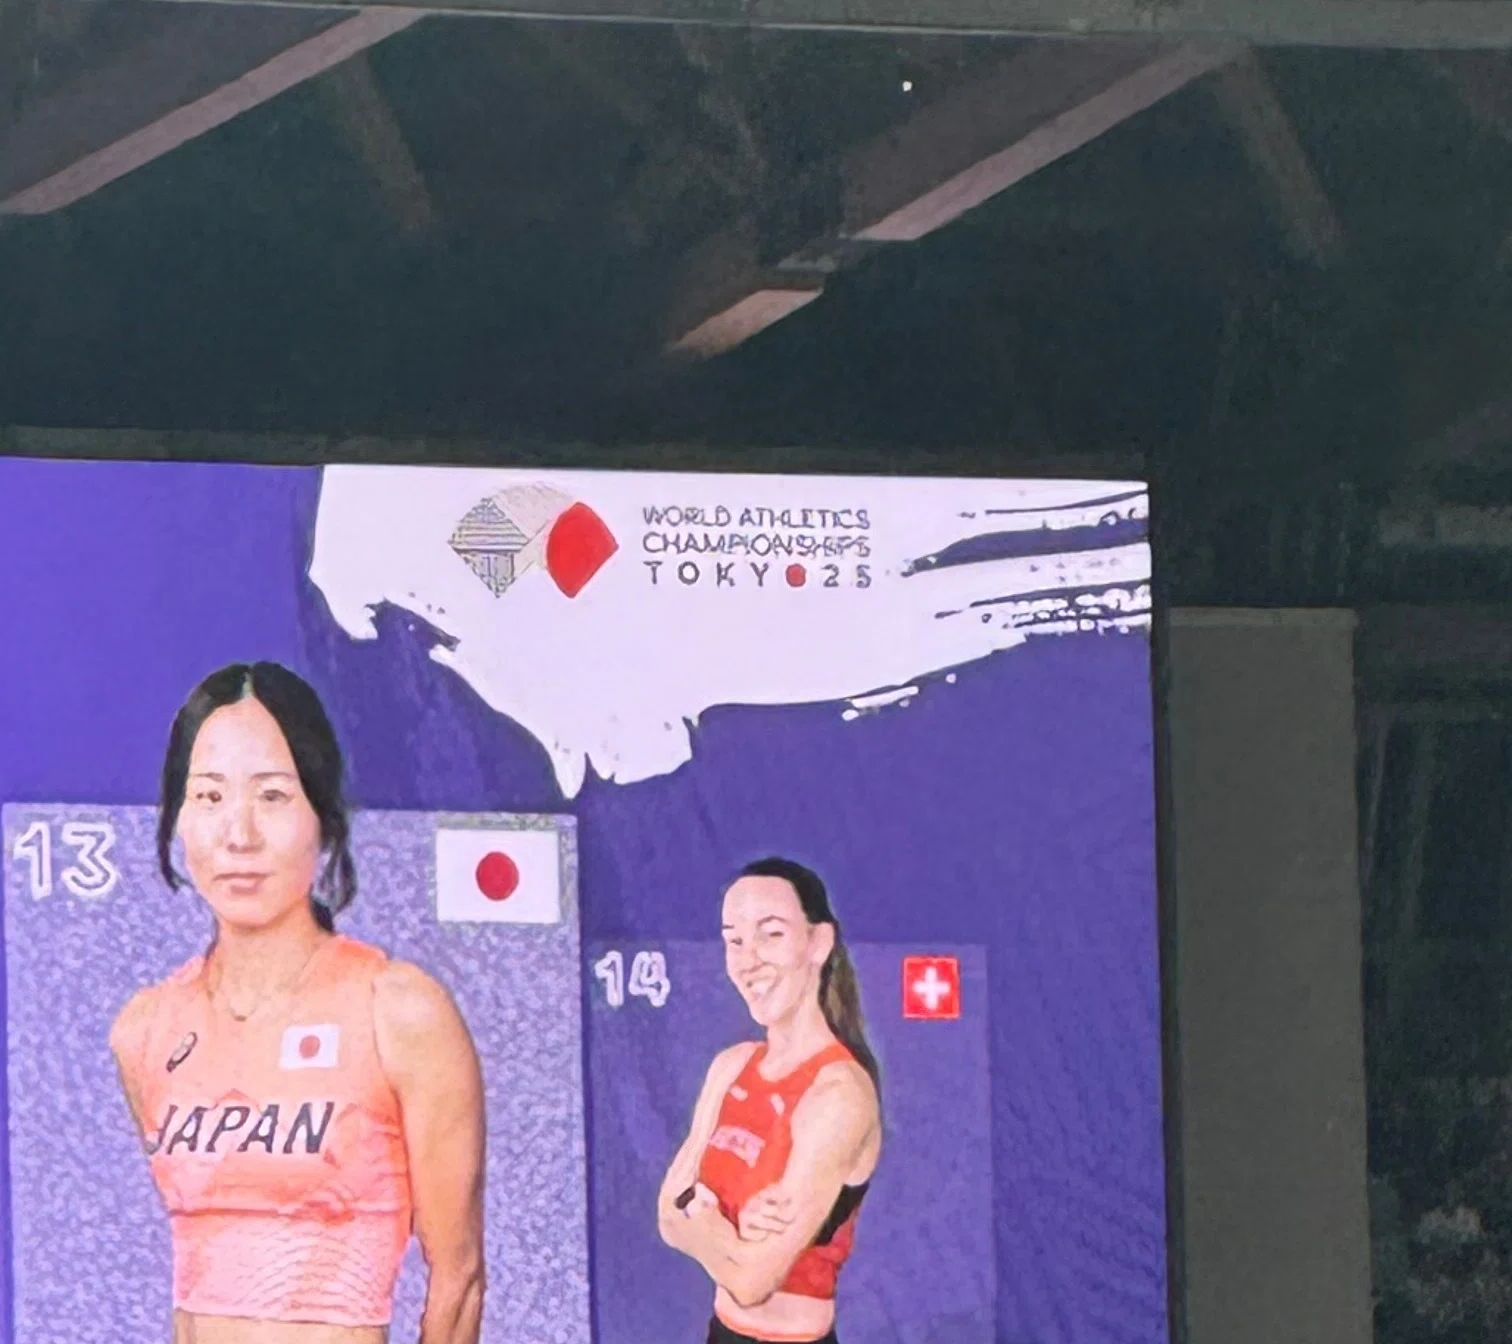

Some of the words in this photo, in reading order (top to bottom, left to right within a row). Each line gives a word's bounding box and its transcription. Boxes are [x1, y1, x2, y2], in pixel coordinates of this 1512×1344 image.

[642, 505, 731, 527] WORLD
[738, 507, 871, 530] ATHLETICS
[13, 821, 117, 900] 13
[594, 950, 671, 1008] 14
[143, 1102, 335, 1156] JAPAN
